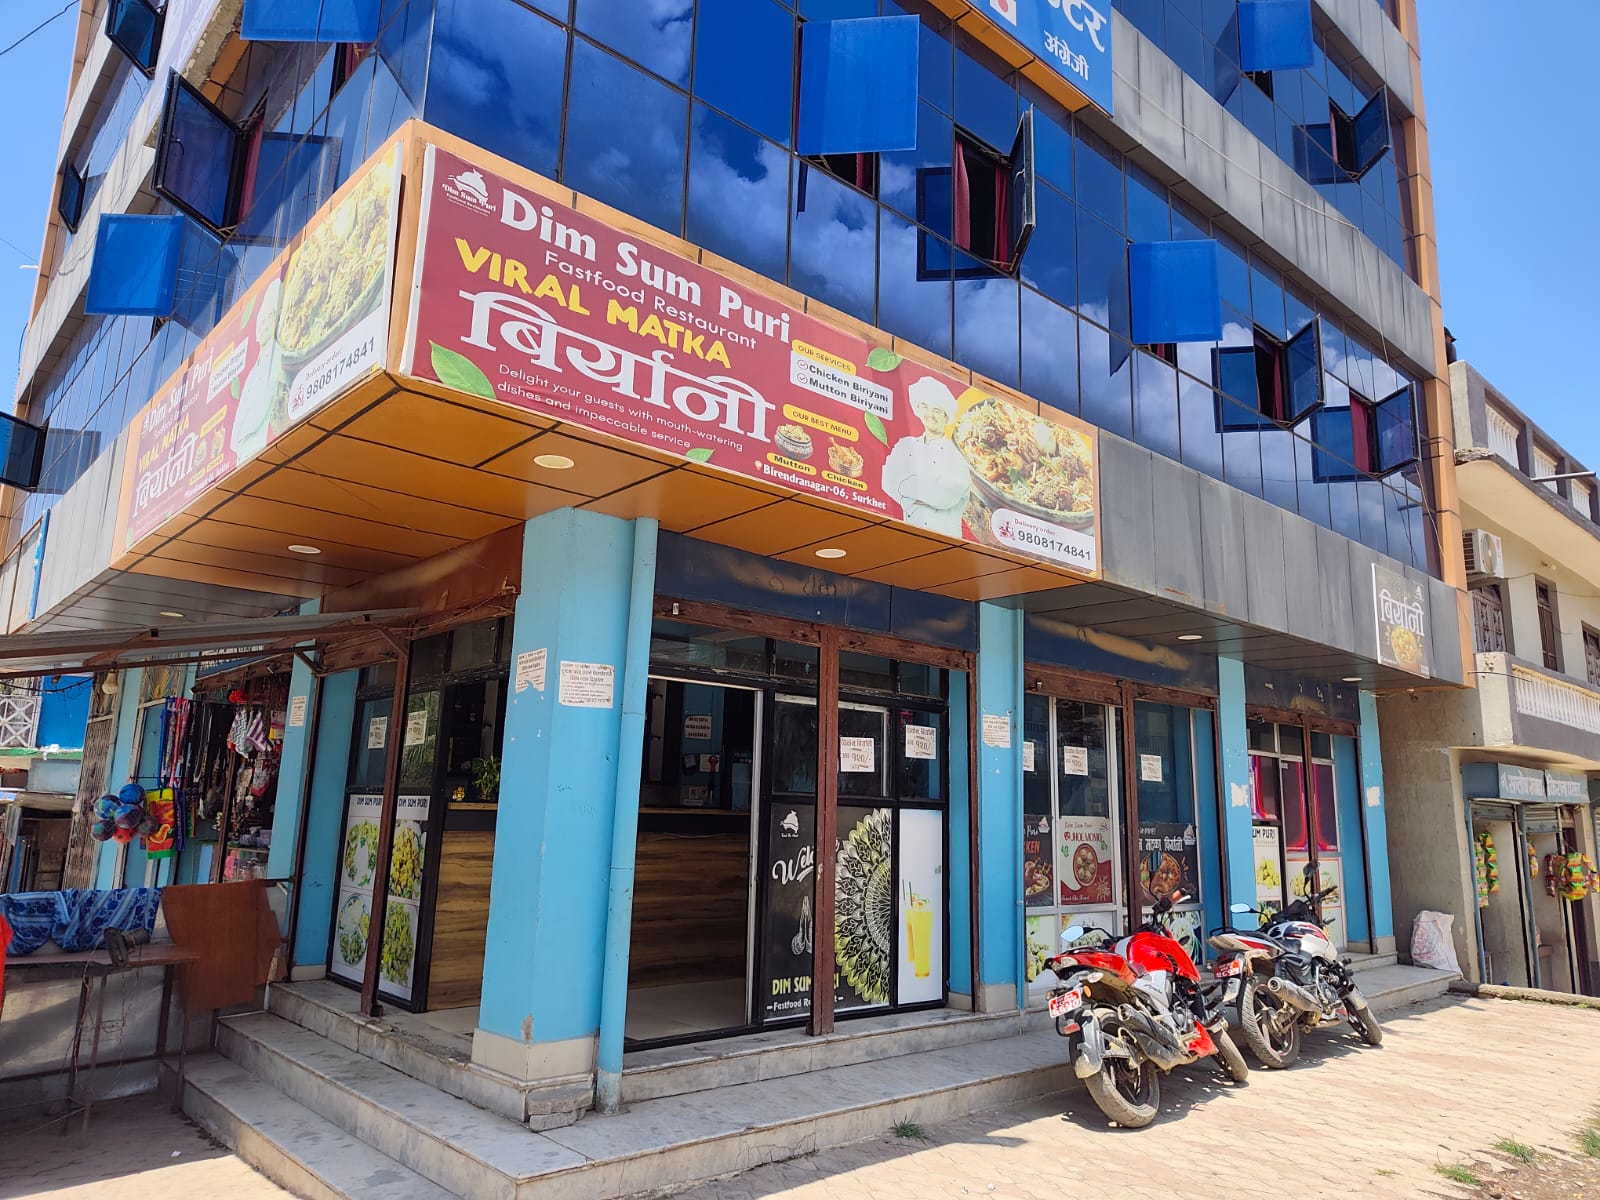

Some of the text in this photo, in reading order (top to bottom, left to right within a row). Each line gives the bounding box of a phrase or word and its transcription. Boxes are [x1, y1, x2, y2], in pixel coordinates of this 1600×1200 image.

[500, 187, 791, 343] Dim Sum Puri
[454, 237, 731, 369] VIRAL MATKA
[545, 250, 757, 350] Fastfood Restaurant
[306, 335, 374, 400] 9808174841
[459, 290, 776, 444] बिर्यानी
[797, 345, 851, 372] OUR SERVICES
[809, 365, 888, 403] Chicken Biriyani
[149, 345, 214, 433] Dim Sum Puri
[497, 381, 691, 449] dishes and impeccable service
[499, 363, 743, 452] Delight your guests with mouth-watering
[809, 377, 888, 414] Mutton Biriyani
[792, 410, 852, 436] OUR BEST MENU
[133, 431, 199, 518] बिर्यानी
[763, 464, 887, 509] Birendranagar-06, Surkhet
[773, 455, 811, 473] Mutton
[826, 472, 864, 489] Chicken
[1017, 530, 1091, 561] 9808174841
[772, 977, 791, 996] DIM
